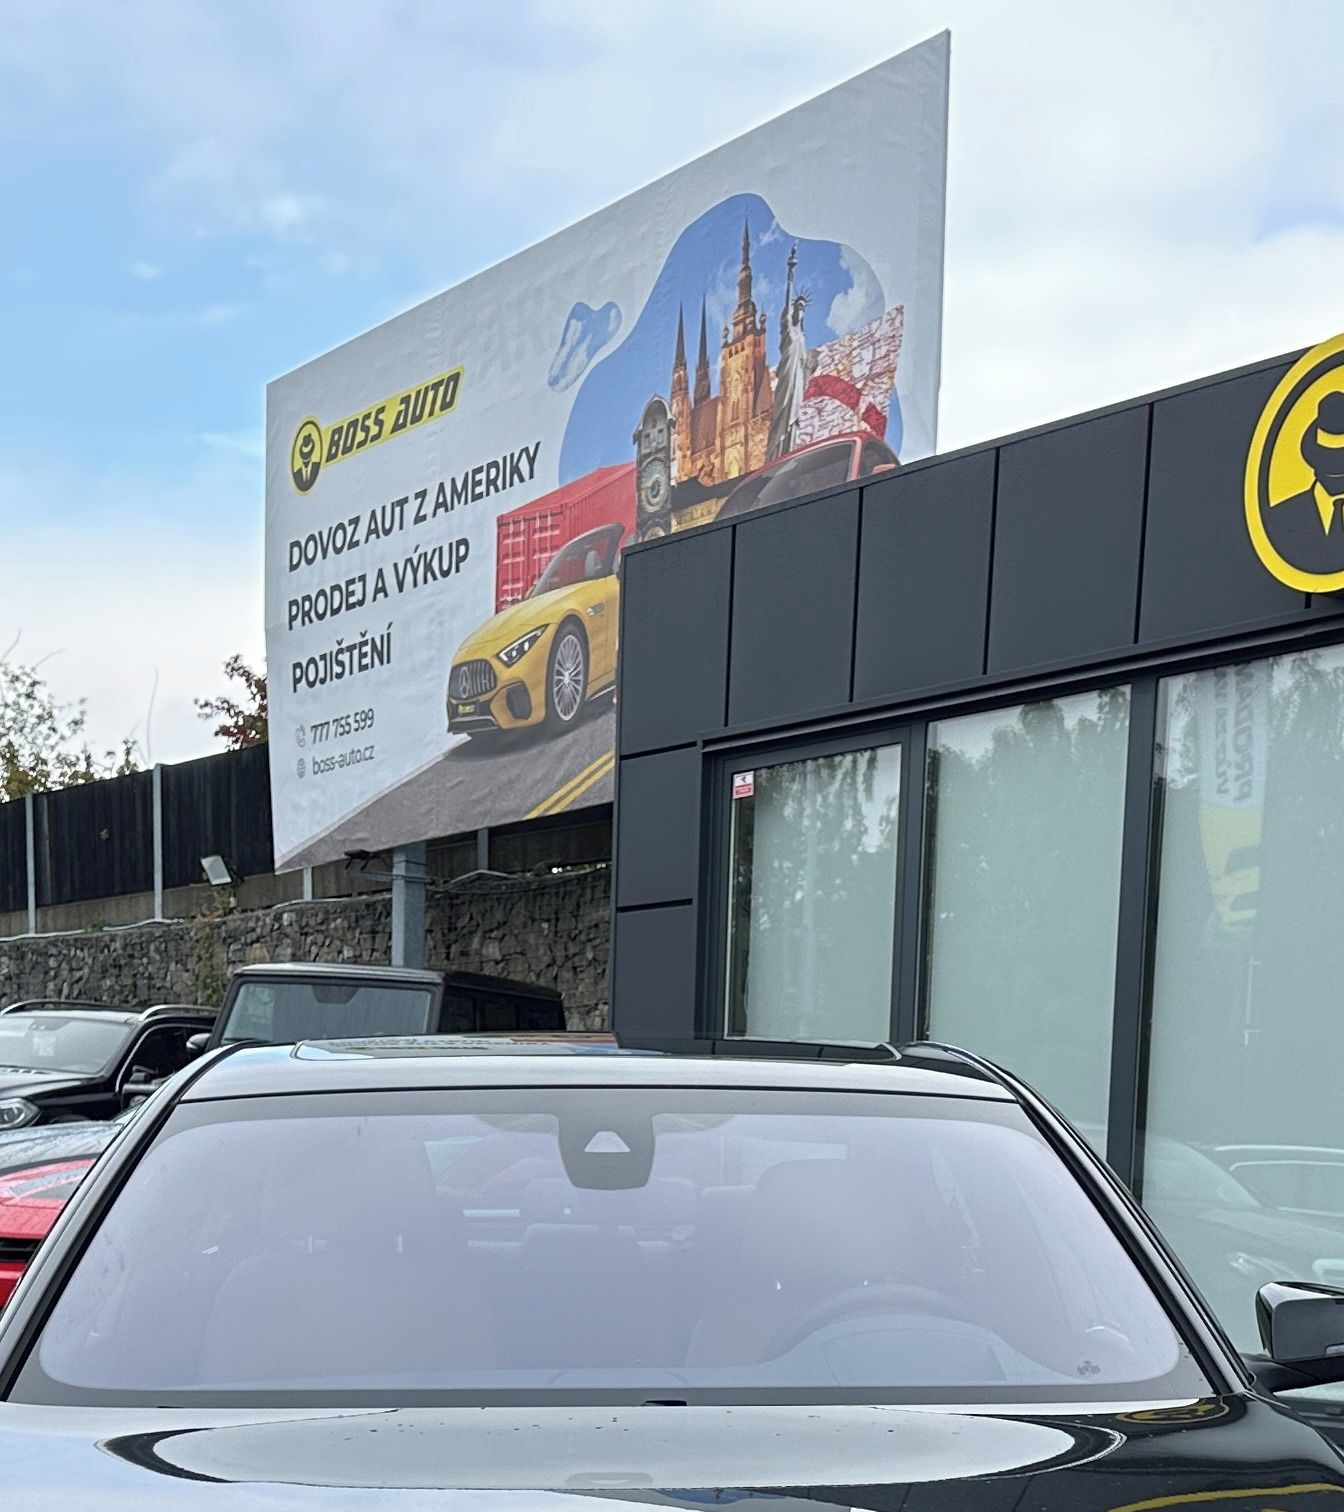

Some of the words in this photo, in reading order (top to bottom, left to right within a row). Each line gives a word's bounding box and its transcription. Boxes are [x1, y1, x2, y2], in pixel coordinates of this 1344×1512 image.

[325, 405, 386, 464] BOSS
[390, 371, 461, 435] AUTO
[289, 515, 360, 573] DOVOZ
[364, 496, 409, 545] AUT
[413, 488, 428, 526] Z
[432, 440, 542, 519] AMERIKY
[288, 573, 367, 631] PRODEJ
[372, 567, 389, 602] A
[393, 538, 470, 594] VÝKUP
[292, 622, 393, 693] POJIŠTĚNÍ
[310, 720, 330, 745] 777
[332, 714, 352, 739] 755
[353, 708, 374, 733] 599
[312, 745, 375, 775] boss-auto.cz
